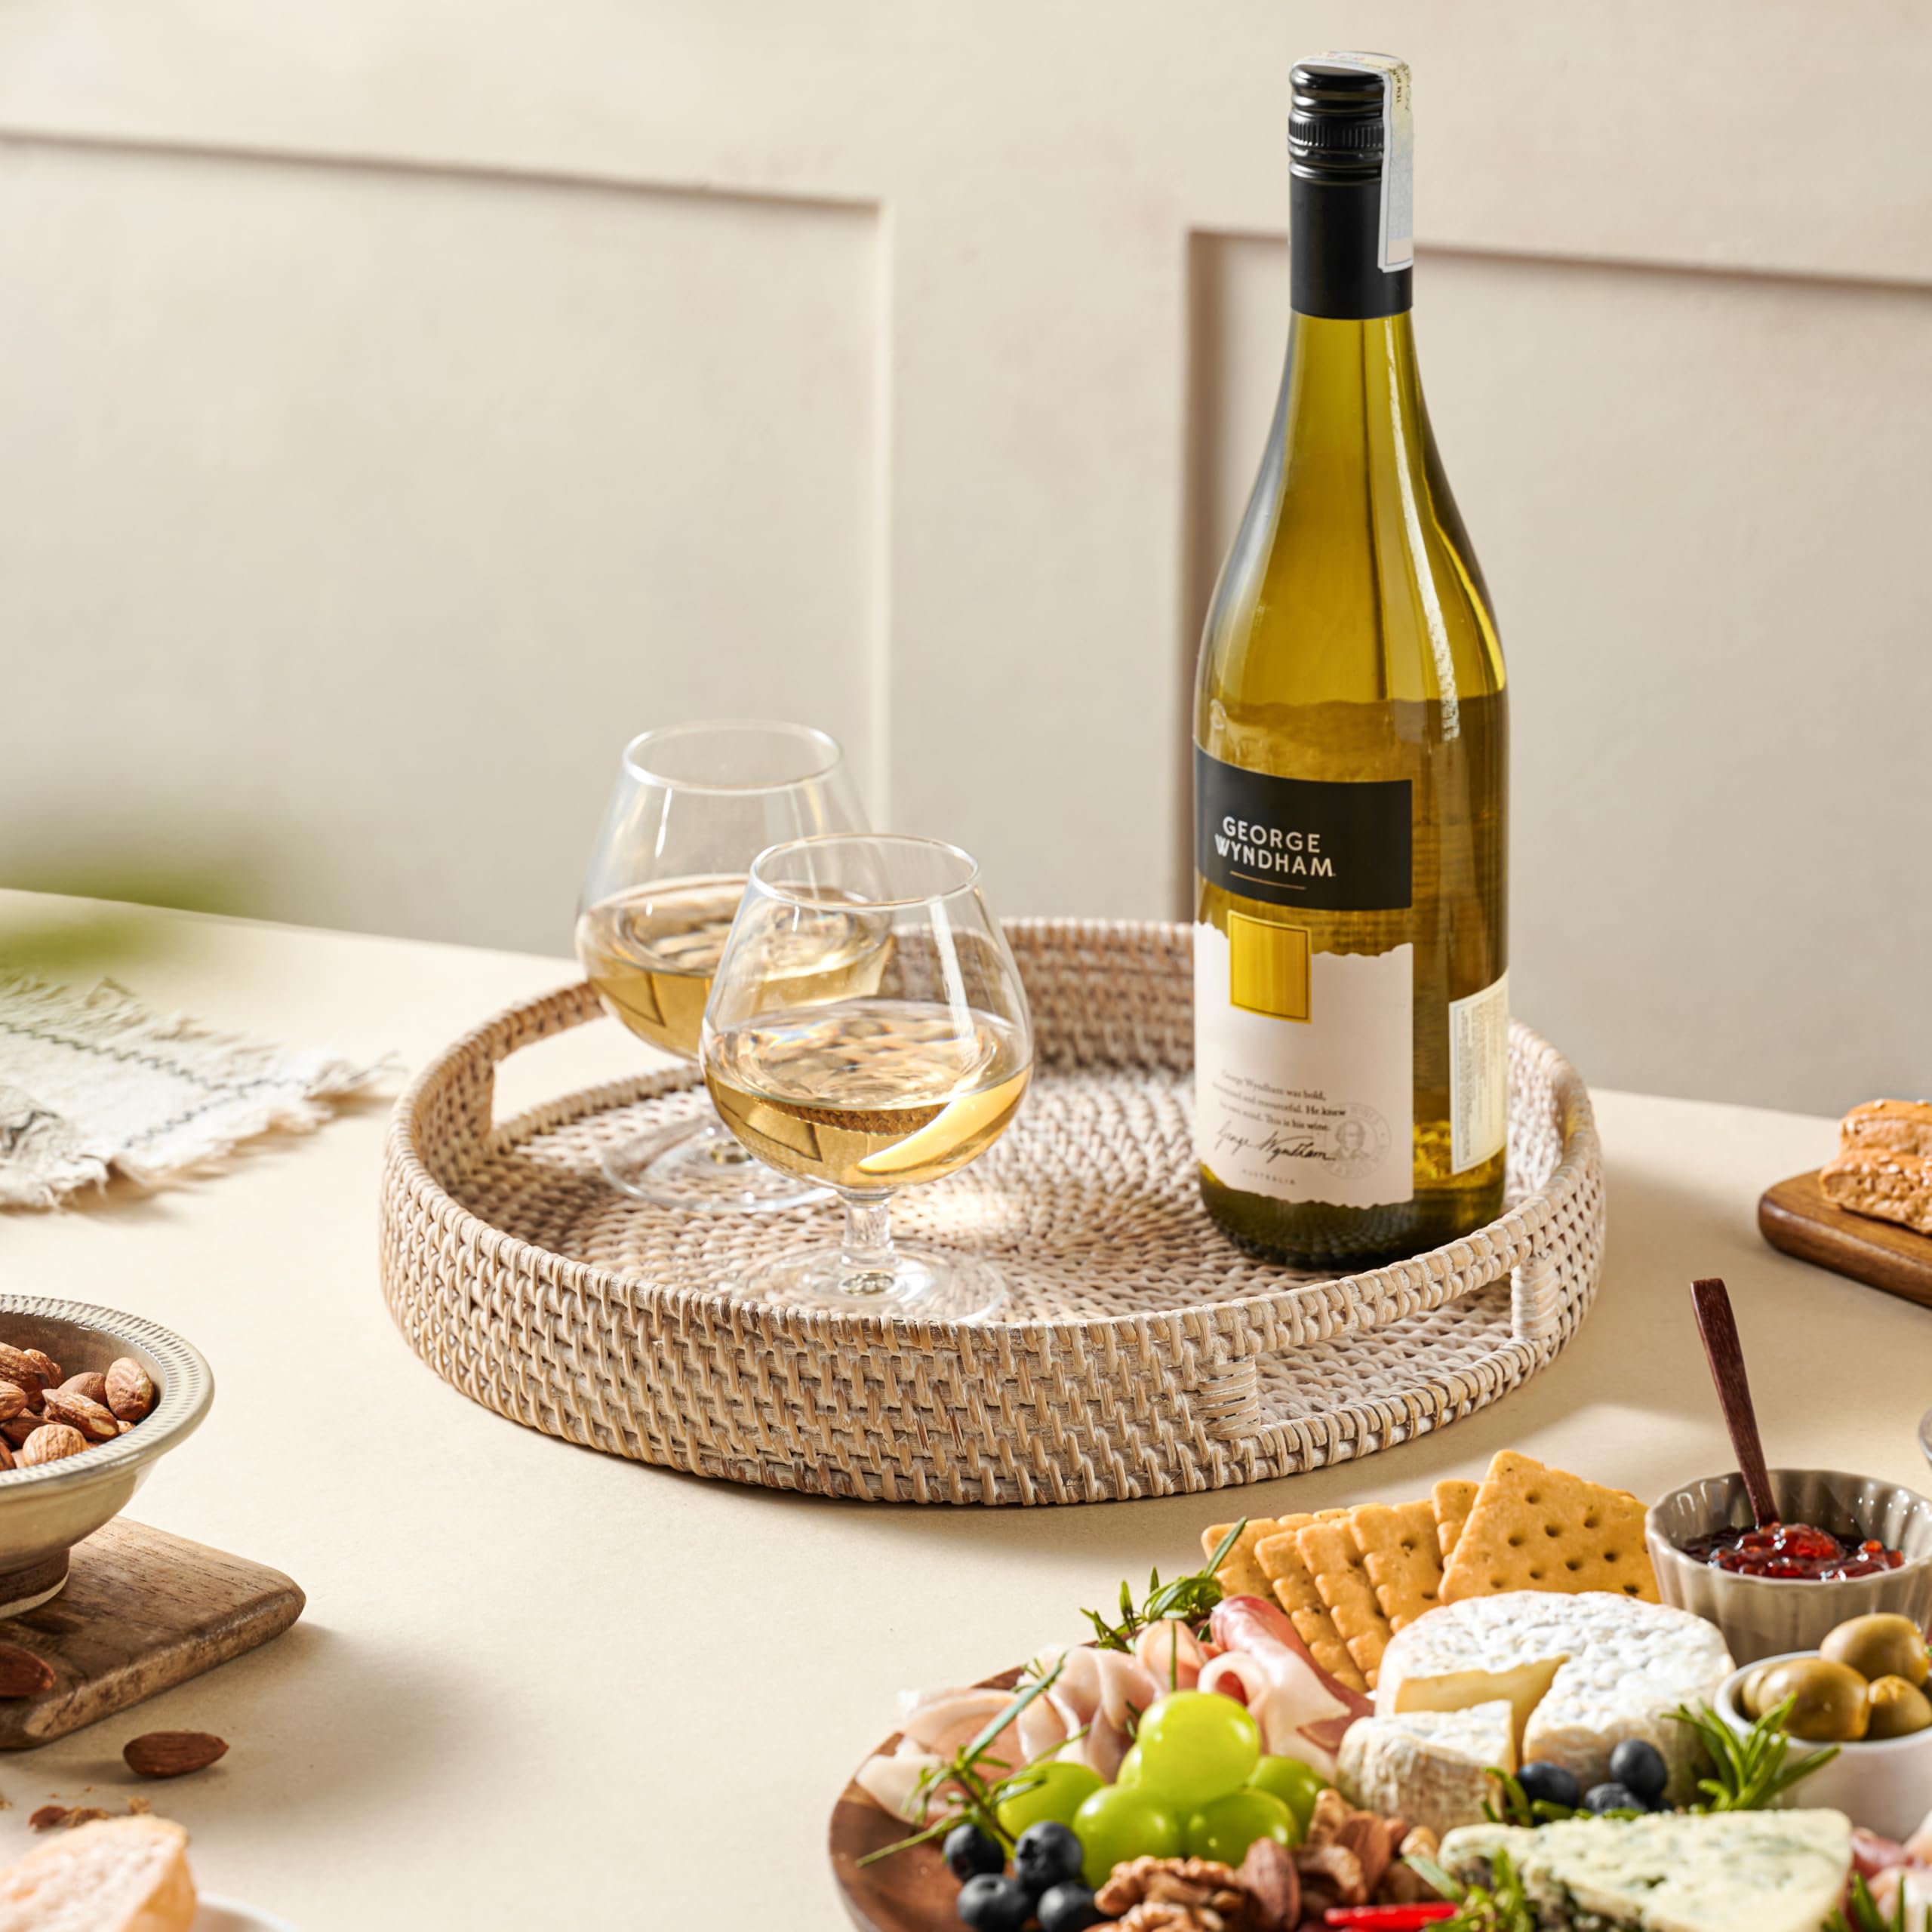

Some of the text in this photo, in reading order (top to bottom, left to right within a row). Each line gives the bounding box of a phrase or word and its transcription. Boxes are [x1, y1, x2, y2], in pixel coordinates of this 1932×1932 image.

[1223, 816, 1320, 853] GEORGE
[1214, 833, 1333, 877] WYNDHAM
[1286, 1090, 1301, 1099] was
[1303, 1089, 1326, 1101] bold,
[1306, 1104, 1318, 1115] He
[1321, 1106, 1346, 1116] knew
[1284, 1118, 1290, 1127] is
[1291, 1118, 1304, 1129] his
[1306, 1122, 1331, 1131] wine.
